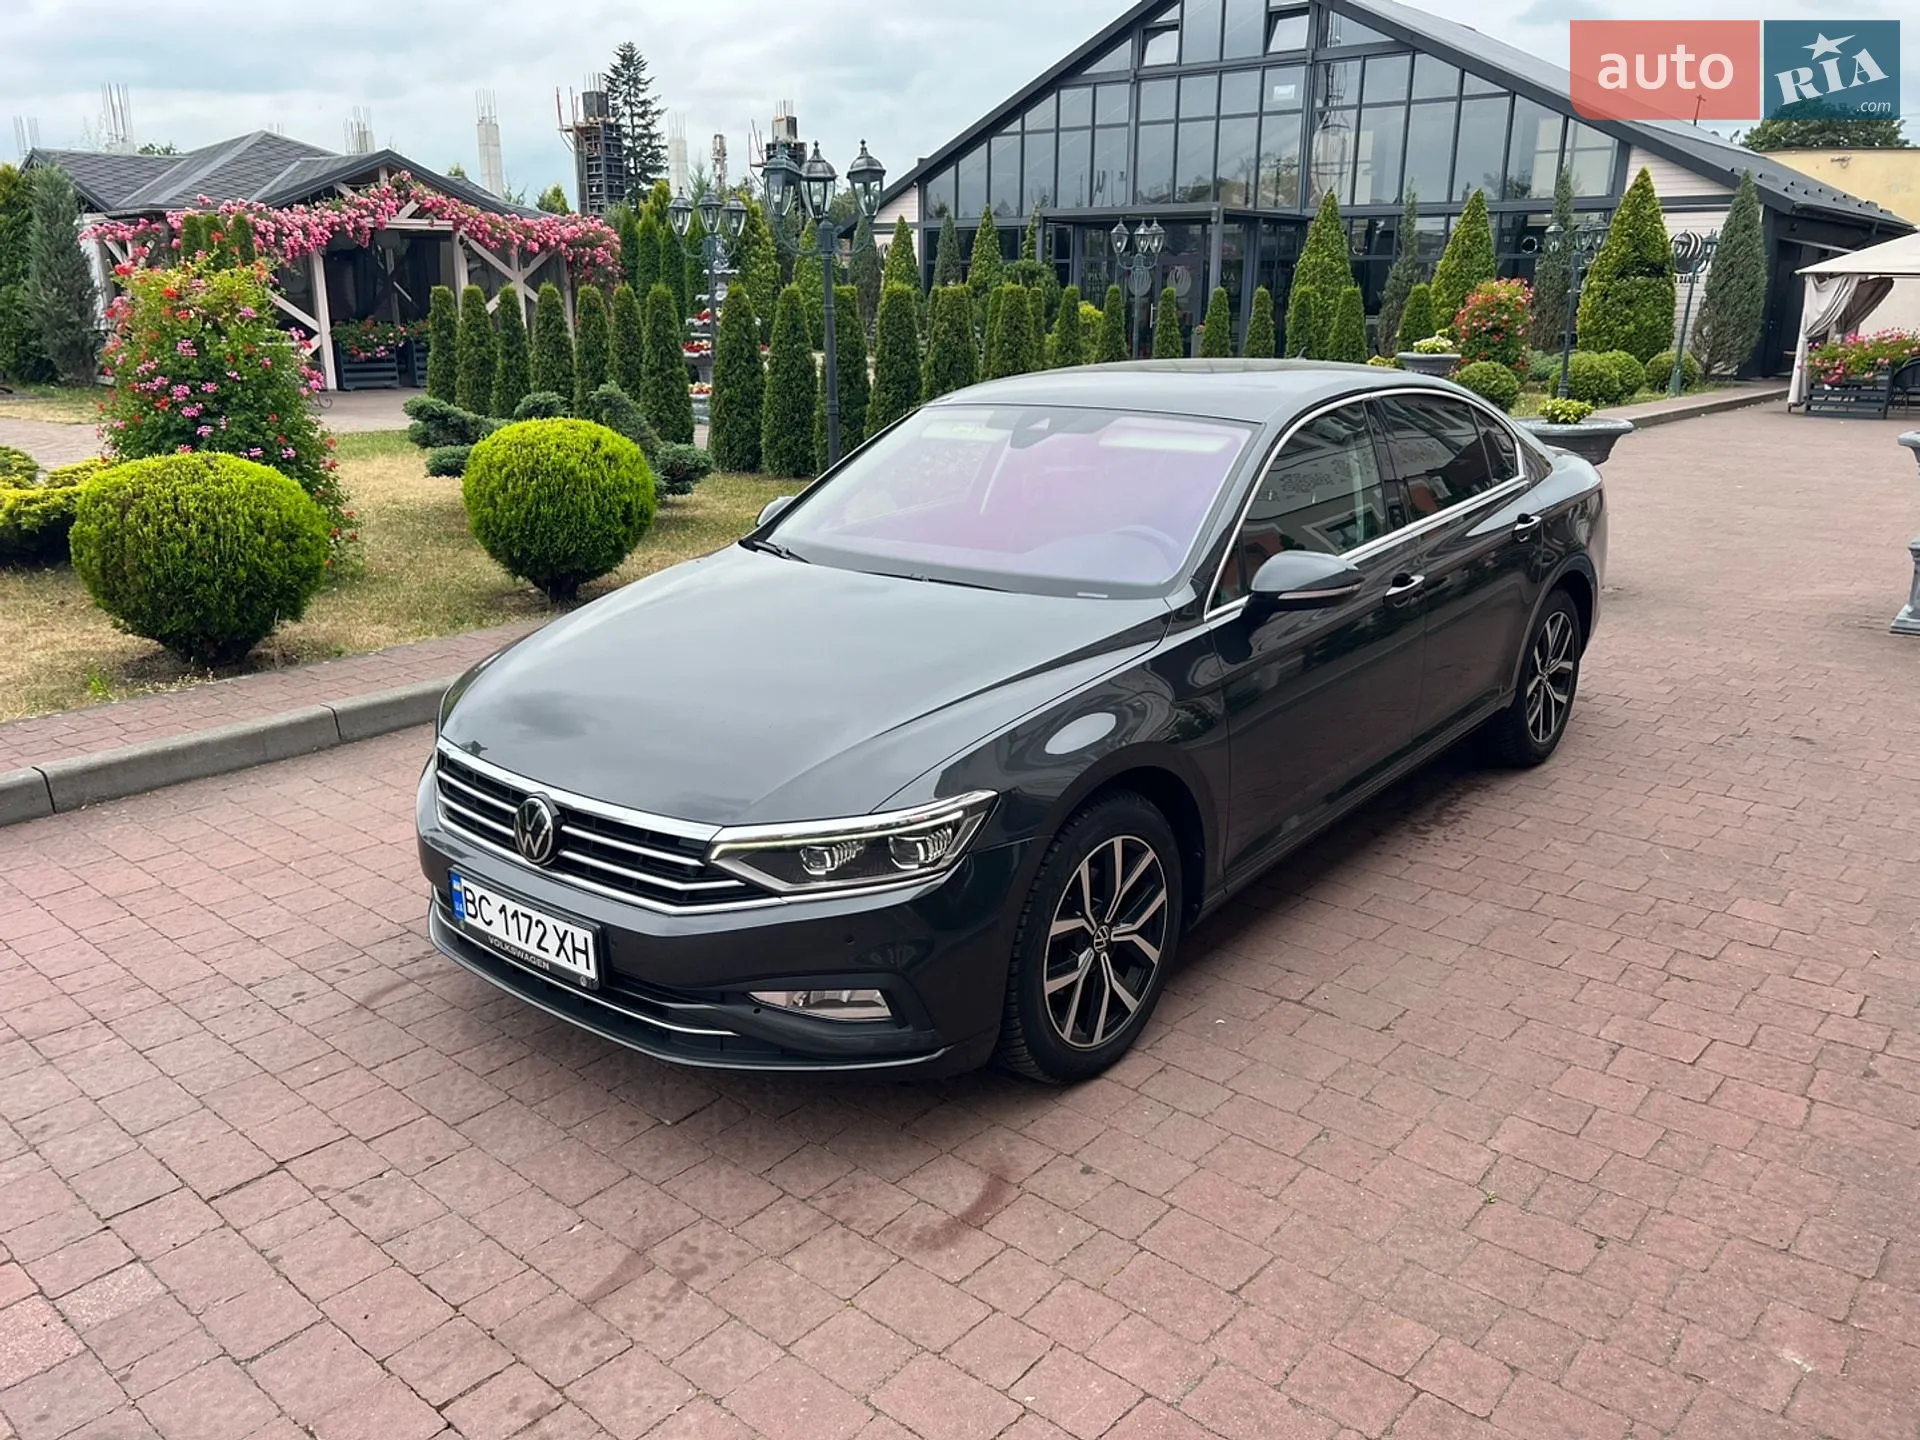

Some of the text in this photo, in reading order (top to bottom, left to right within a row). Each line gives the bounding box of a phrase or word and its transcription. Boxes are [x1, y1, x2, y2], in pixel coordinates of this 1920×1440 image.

[463, 885, 591, 970] BC 1172 XH
[487, 934, 550, 971] VOLKSWAGEN
